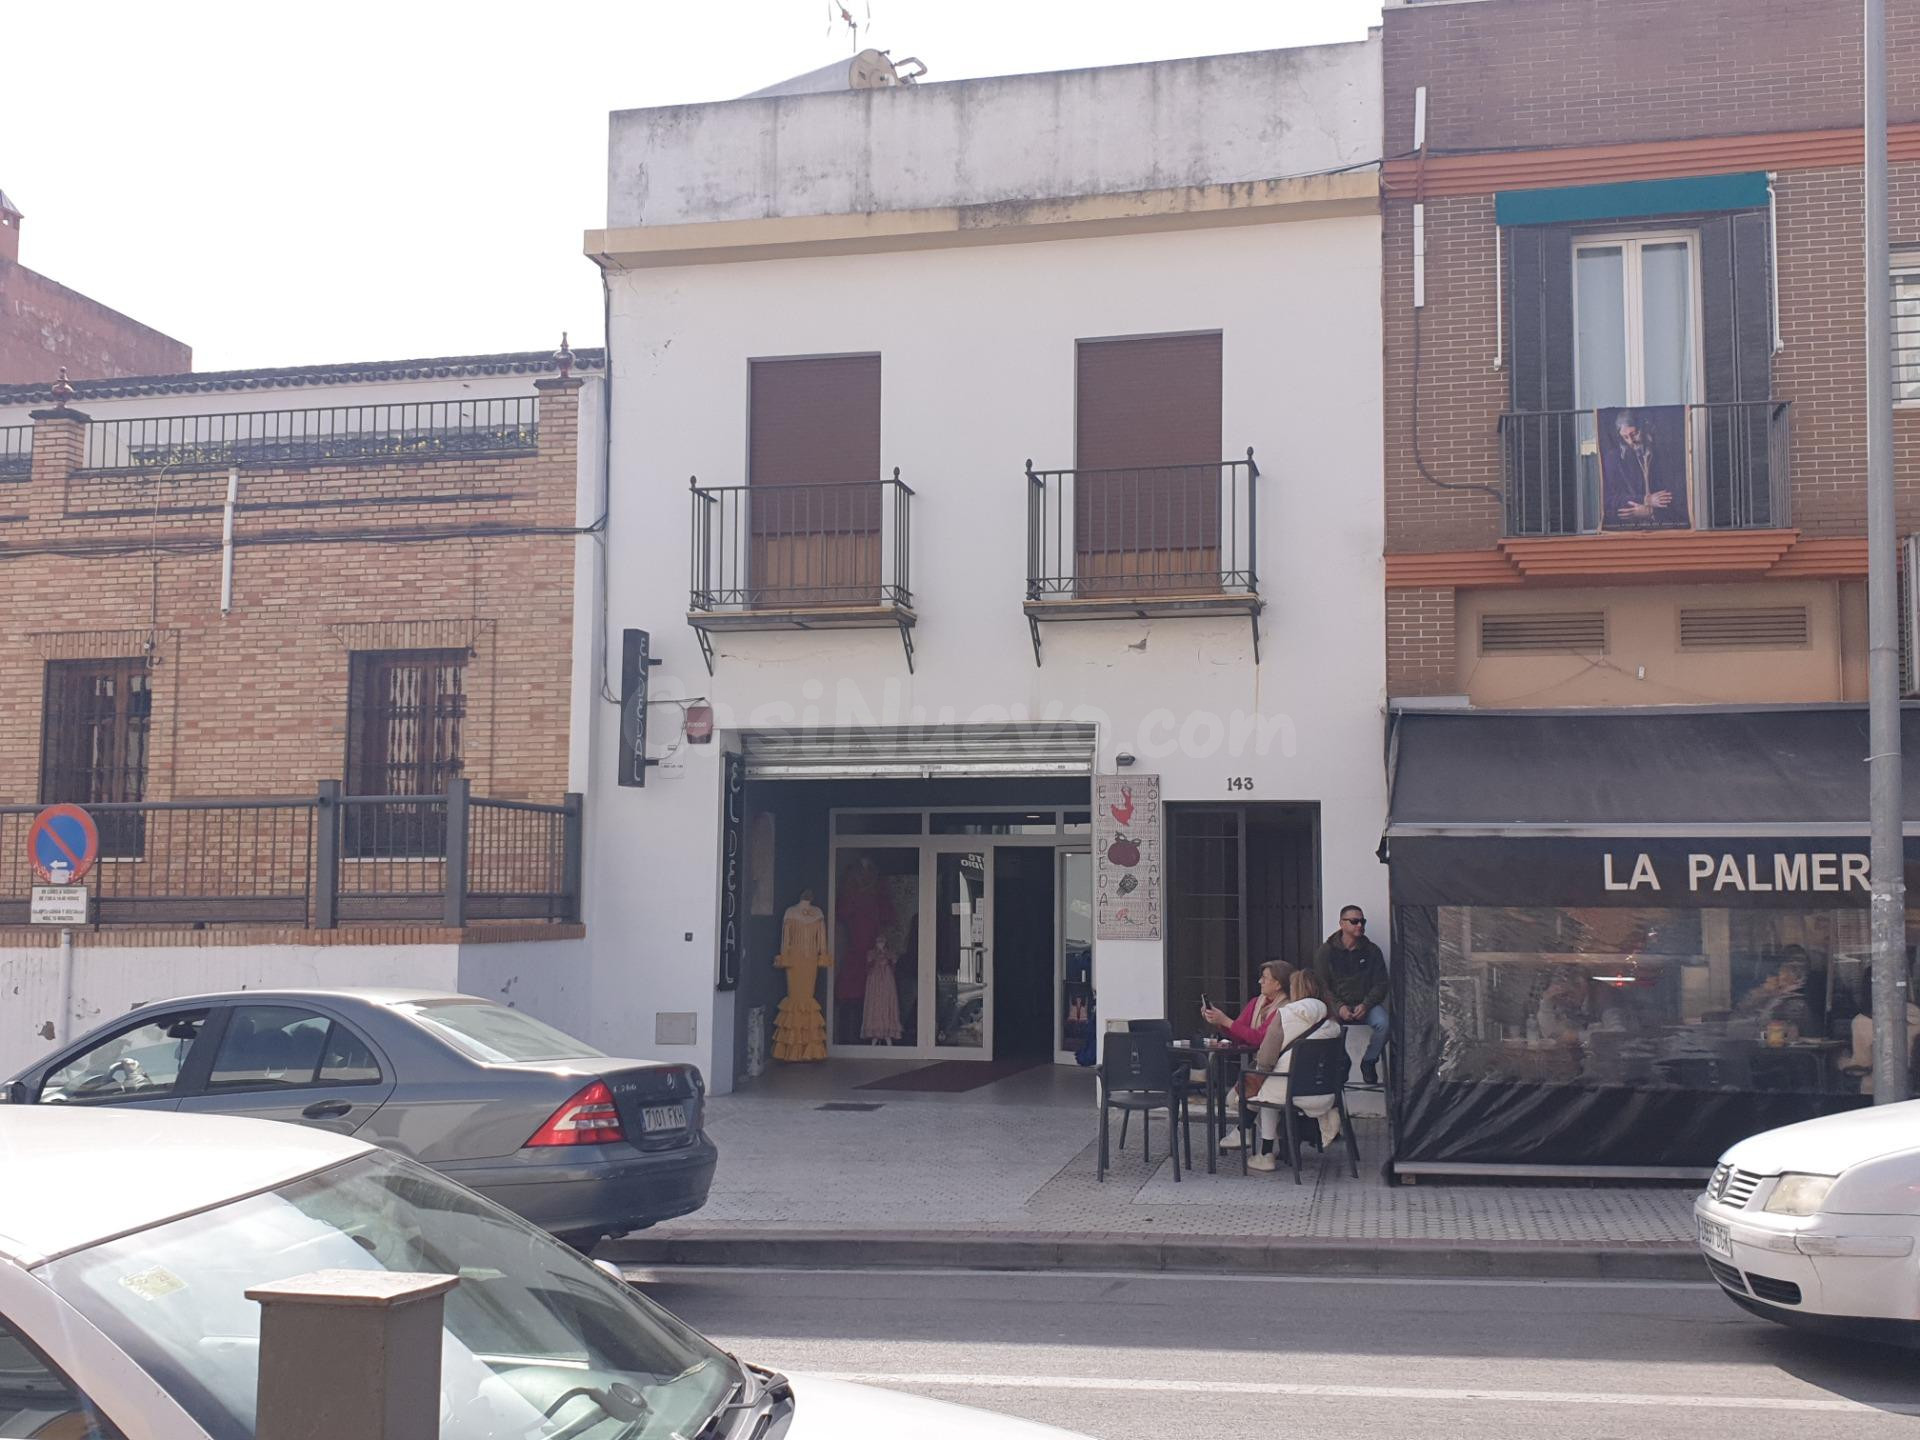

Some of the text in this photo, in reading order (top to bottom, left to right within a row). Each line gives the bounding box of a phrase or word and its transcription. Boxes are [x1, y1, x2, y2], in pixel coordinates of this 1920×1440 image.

[1226, 776, 1255, 792] 143
[1098, 838, 1109, 926] DEDAL
[1147, 776, 1161, 937] MODA FLAMENCA
[1602, 853, 1906, 892] LA PALMER
